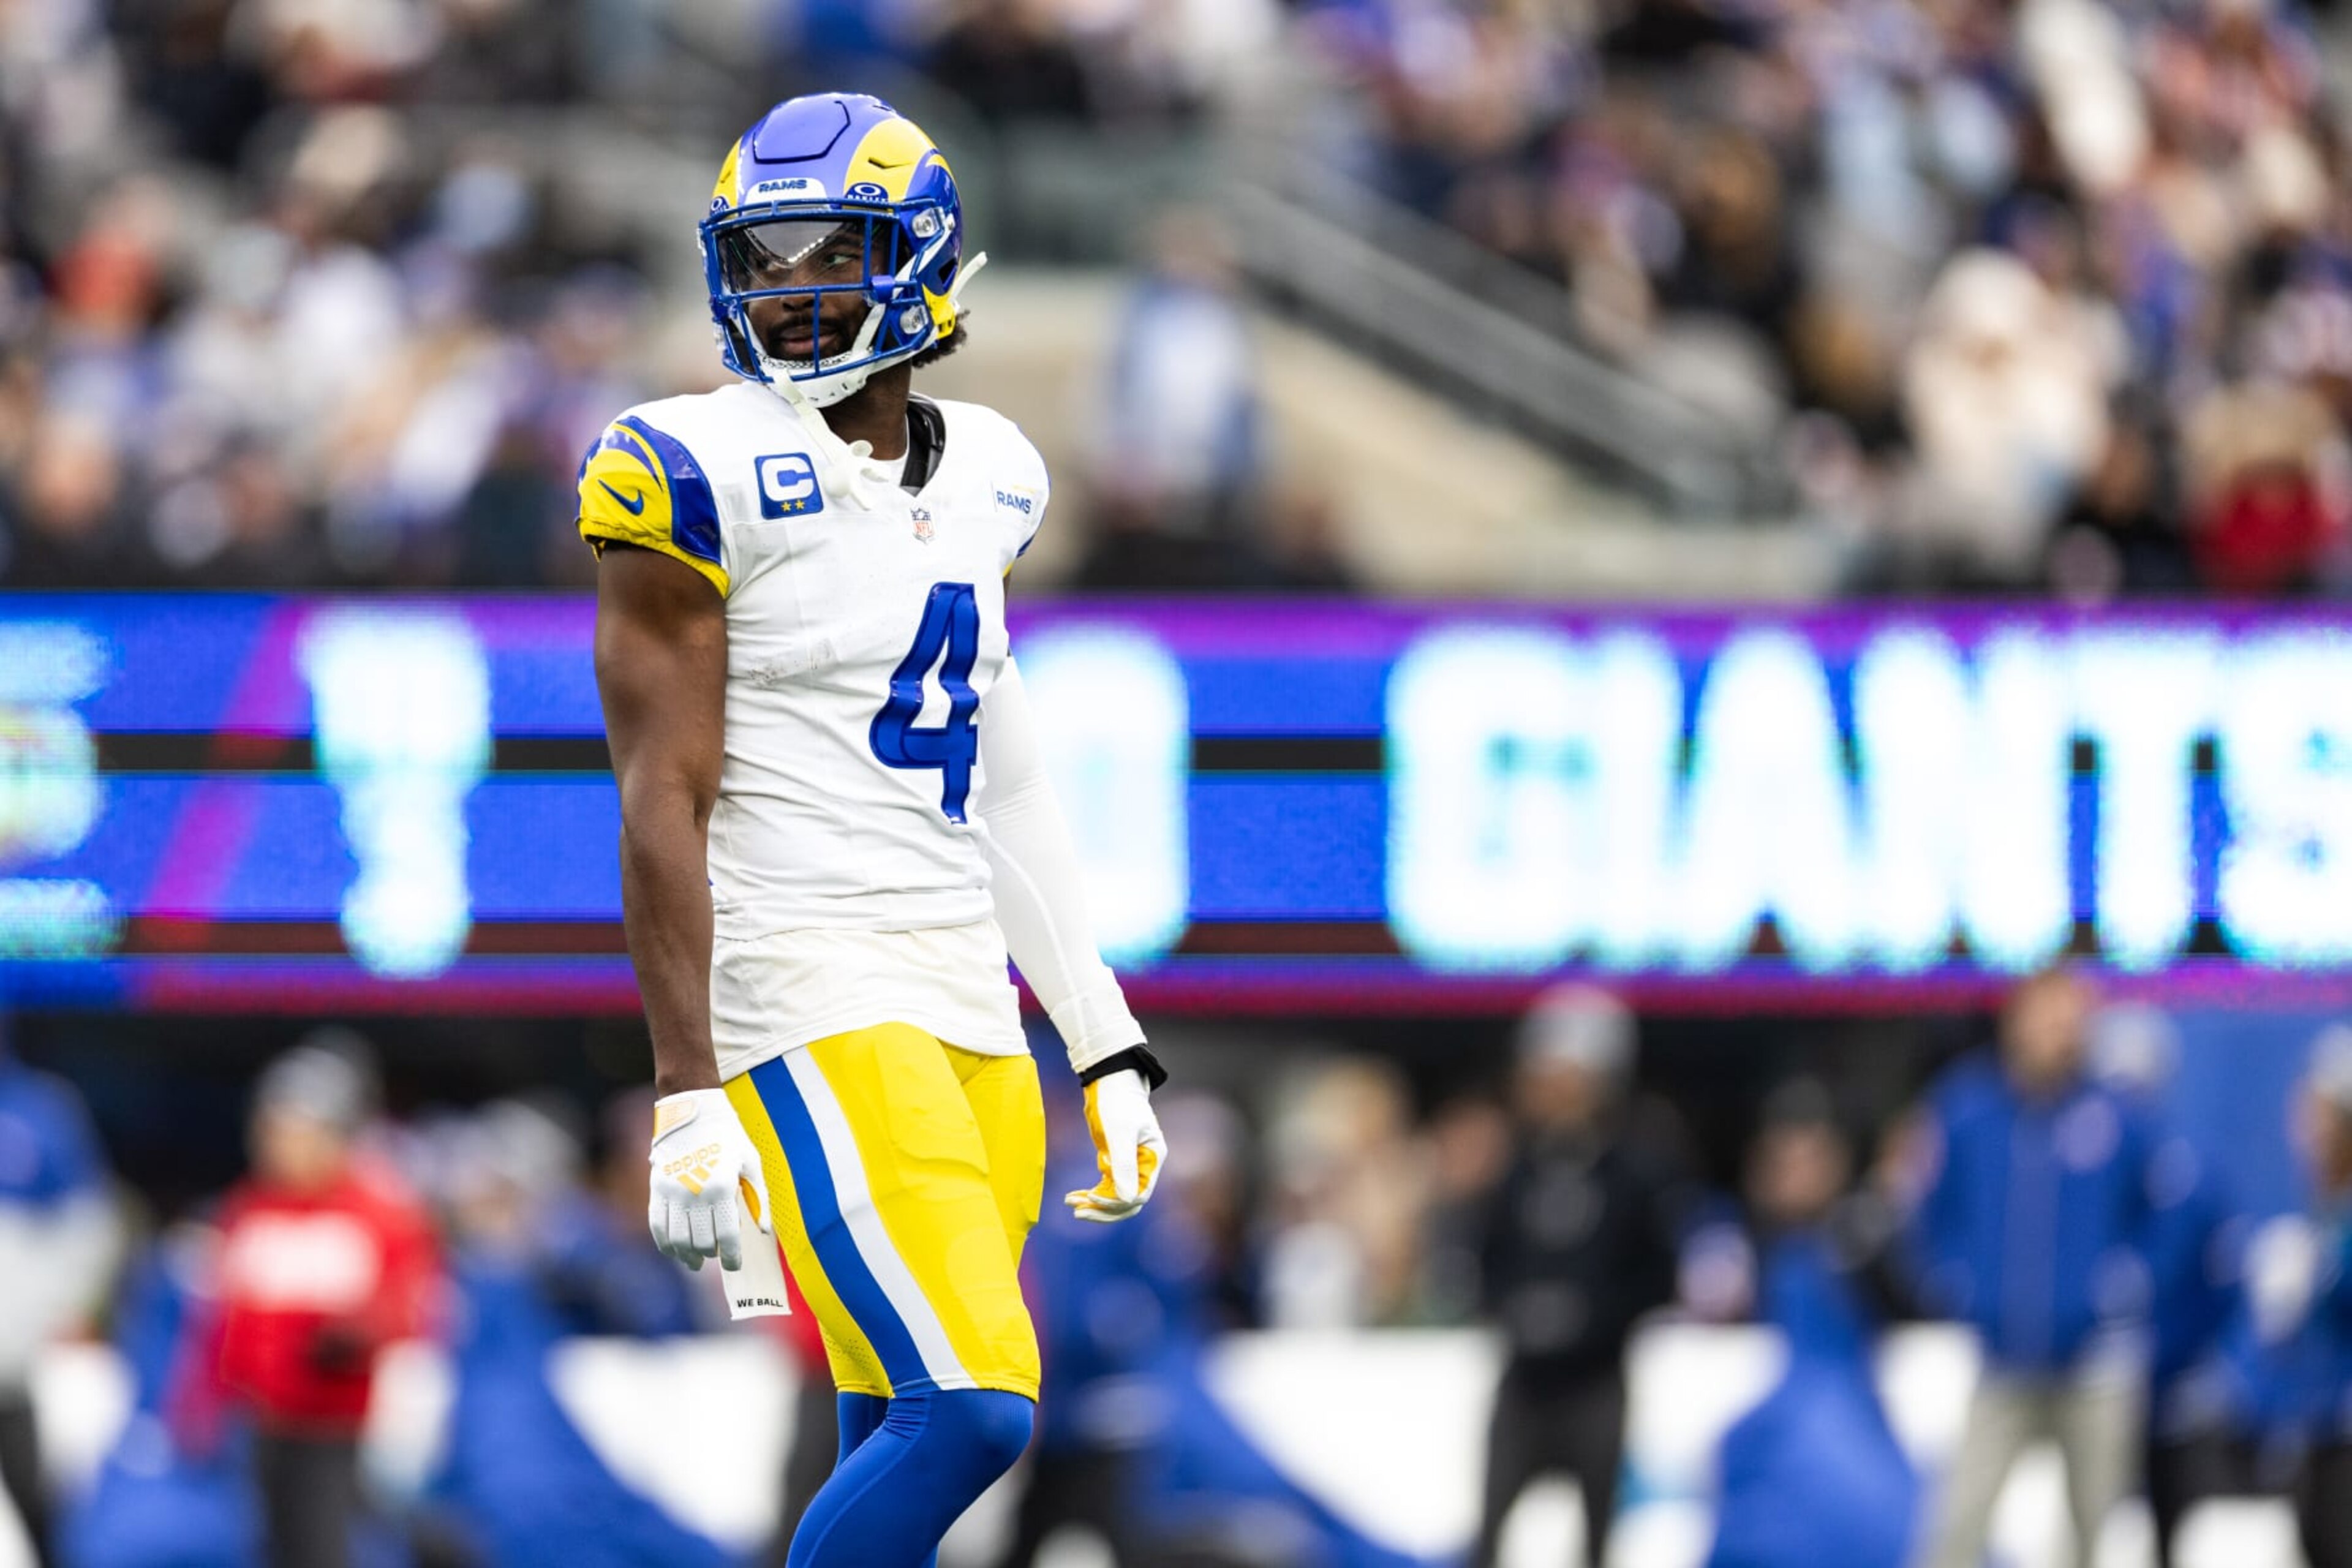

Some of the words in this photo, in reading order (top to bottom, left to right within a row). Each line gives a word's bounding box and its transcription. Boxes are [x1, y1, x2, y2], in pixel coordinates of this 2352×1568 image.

[759, 179, 807, 193] RAMS
[761, 456, 815, 502] C
[997, 491, 1031, 514] RAMS
[914, 522, 934, 537] NFL
[869, 581, 980, 824] 4
[1387, 624, 2352, 975] GIANTS
[663, 1143, 721, 1176] adidas
[737, 1298, 754, 1308] WE
[757, 1298, 783, 1308] BALL
